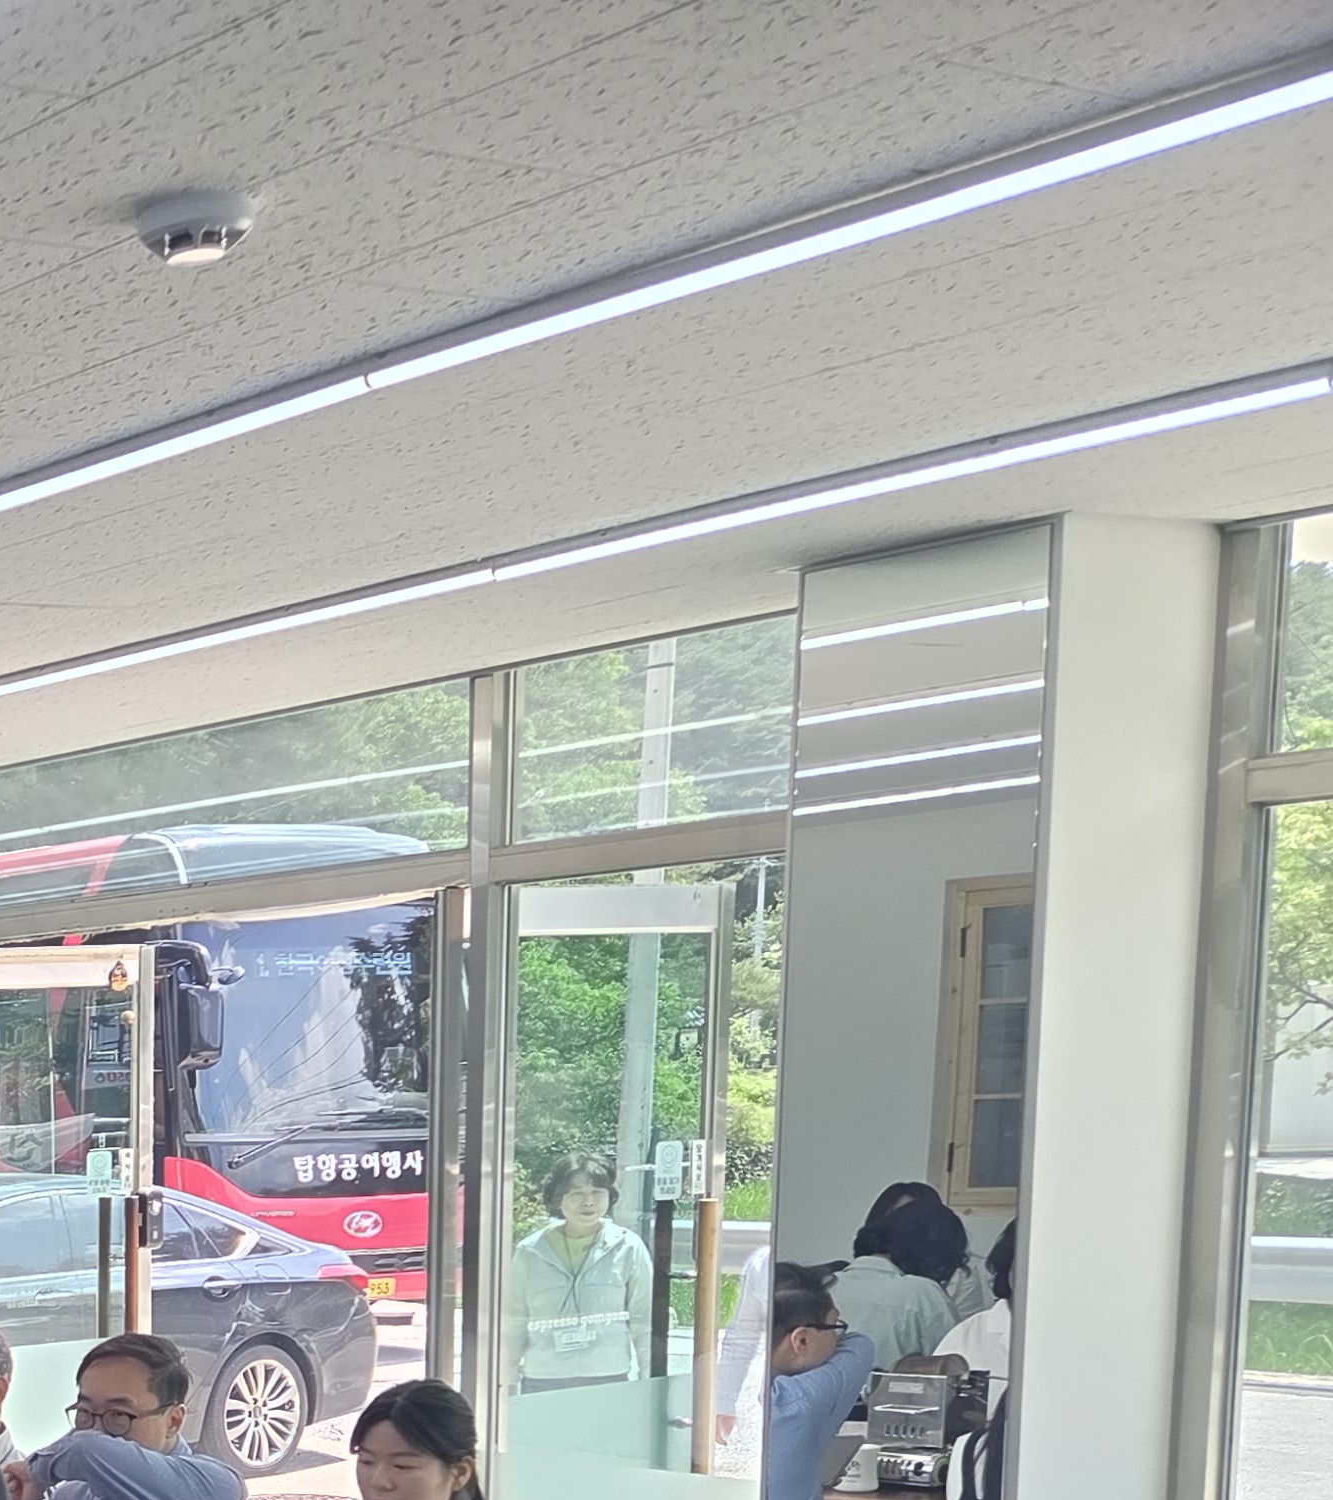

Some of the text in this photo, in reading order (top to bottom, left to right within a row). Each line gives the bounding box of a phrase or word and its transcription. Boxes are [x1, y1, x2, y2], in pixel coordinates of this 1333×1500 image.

[293, 1150, 424, 1183] 탑항공여행사
[527, 1311, 630, 1333] espresso gomgom
